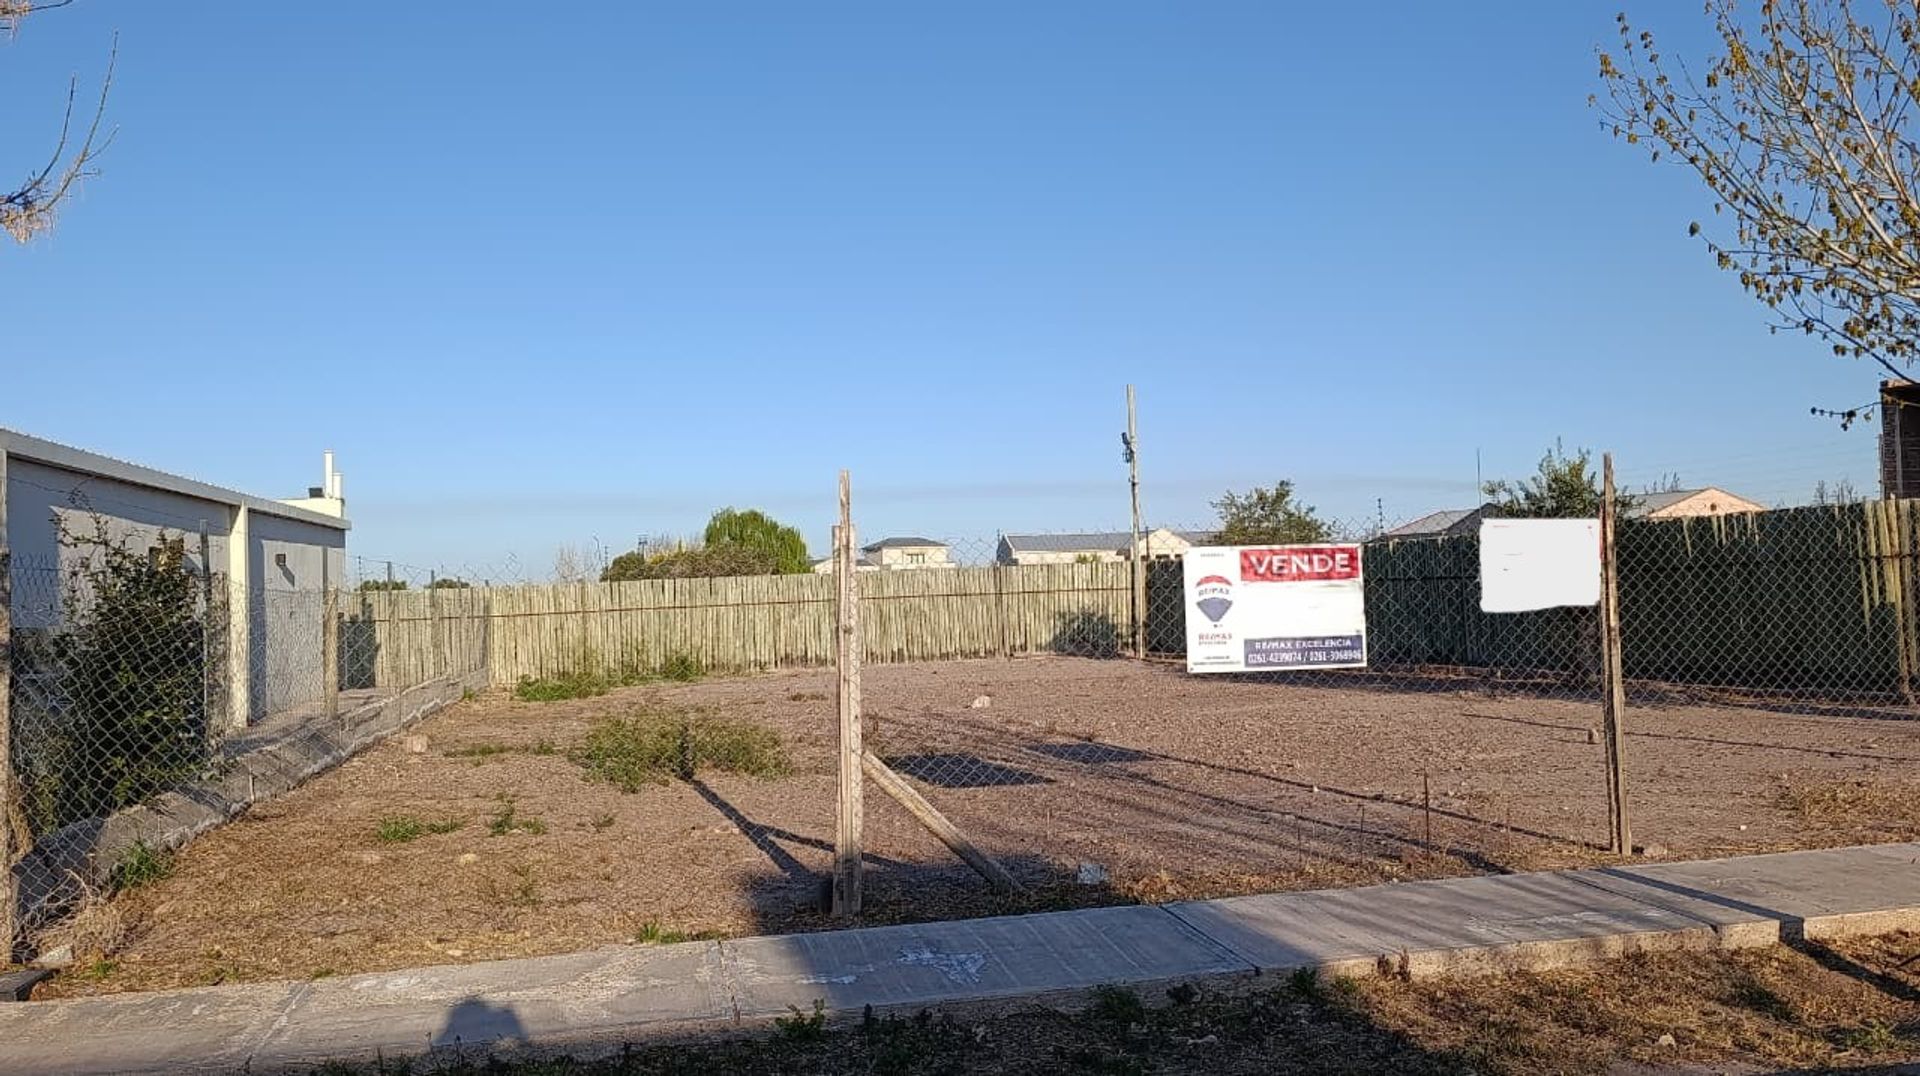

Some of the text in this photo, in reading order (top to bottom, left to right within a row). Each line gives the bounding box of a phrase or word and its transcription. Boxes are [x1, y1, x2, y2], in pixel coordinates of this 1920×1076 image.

[1251, 553, 1350, 574] VENDE
[1255, 638, 1352, 650] RE/MAX EXCELENCIA
